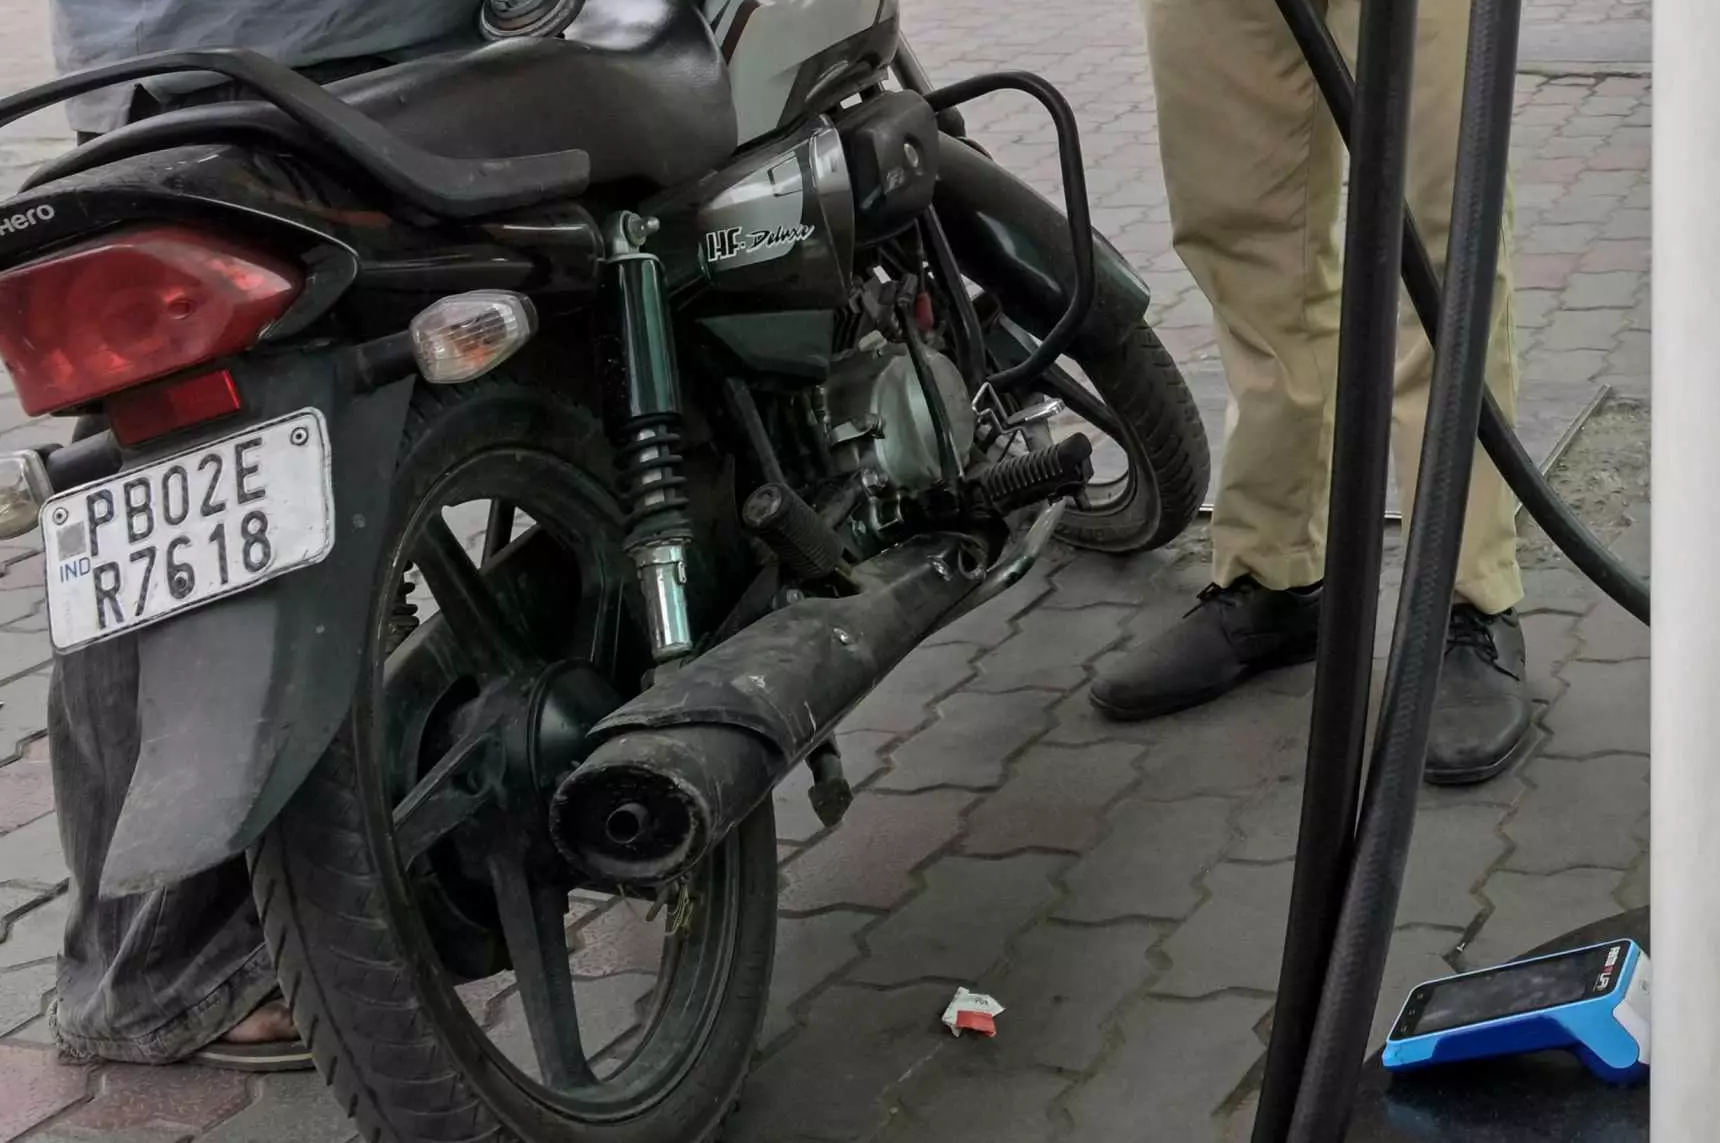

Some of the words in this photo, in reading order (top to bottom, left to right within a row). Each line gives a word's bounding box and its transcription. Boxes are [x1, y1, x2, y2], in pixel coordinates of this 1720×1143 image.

[0, 204, 55, 236] Hero
[86, 436, 267, 557] PB02E
[59, 556, 91, 584] IND
[93, 509, 272, 629] R7618
